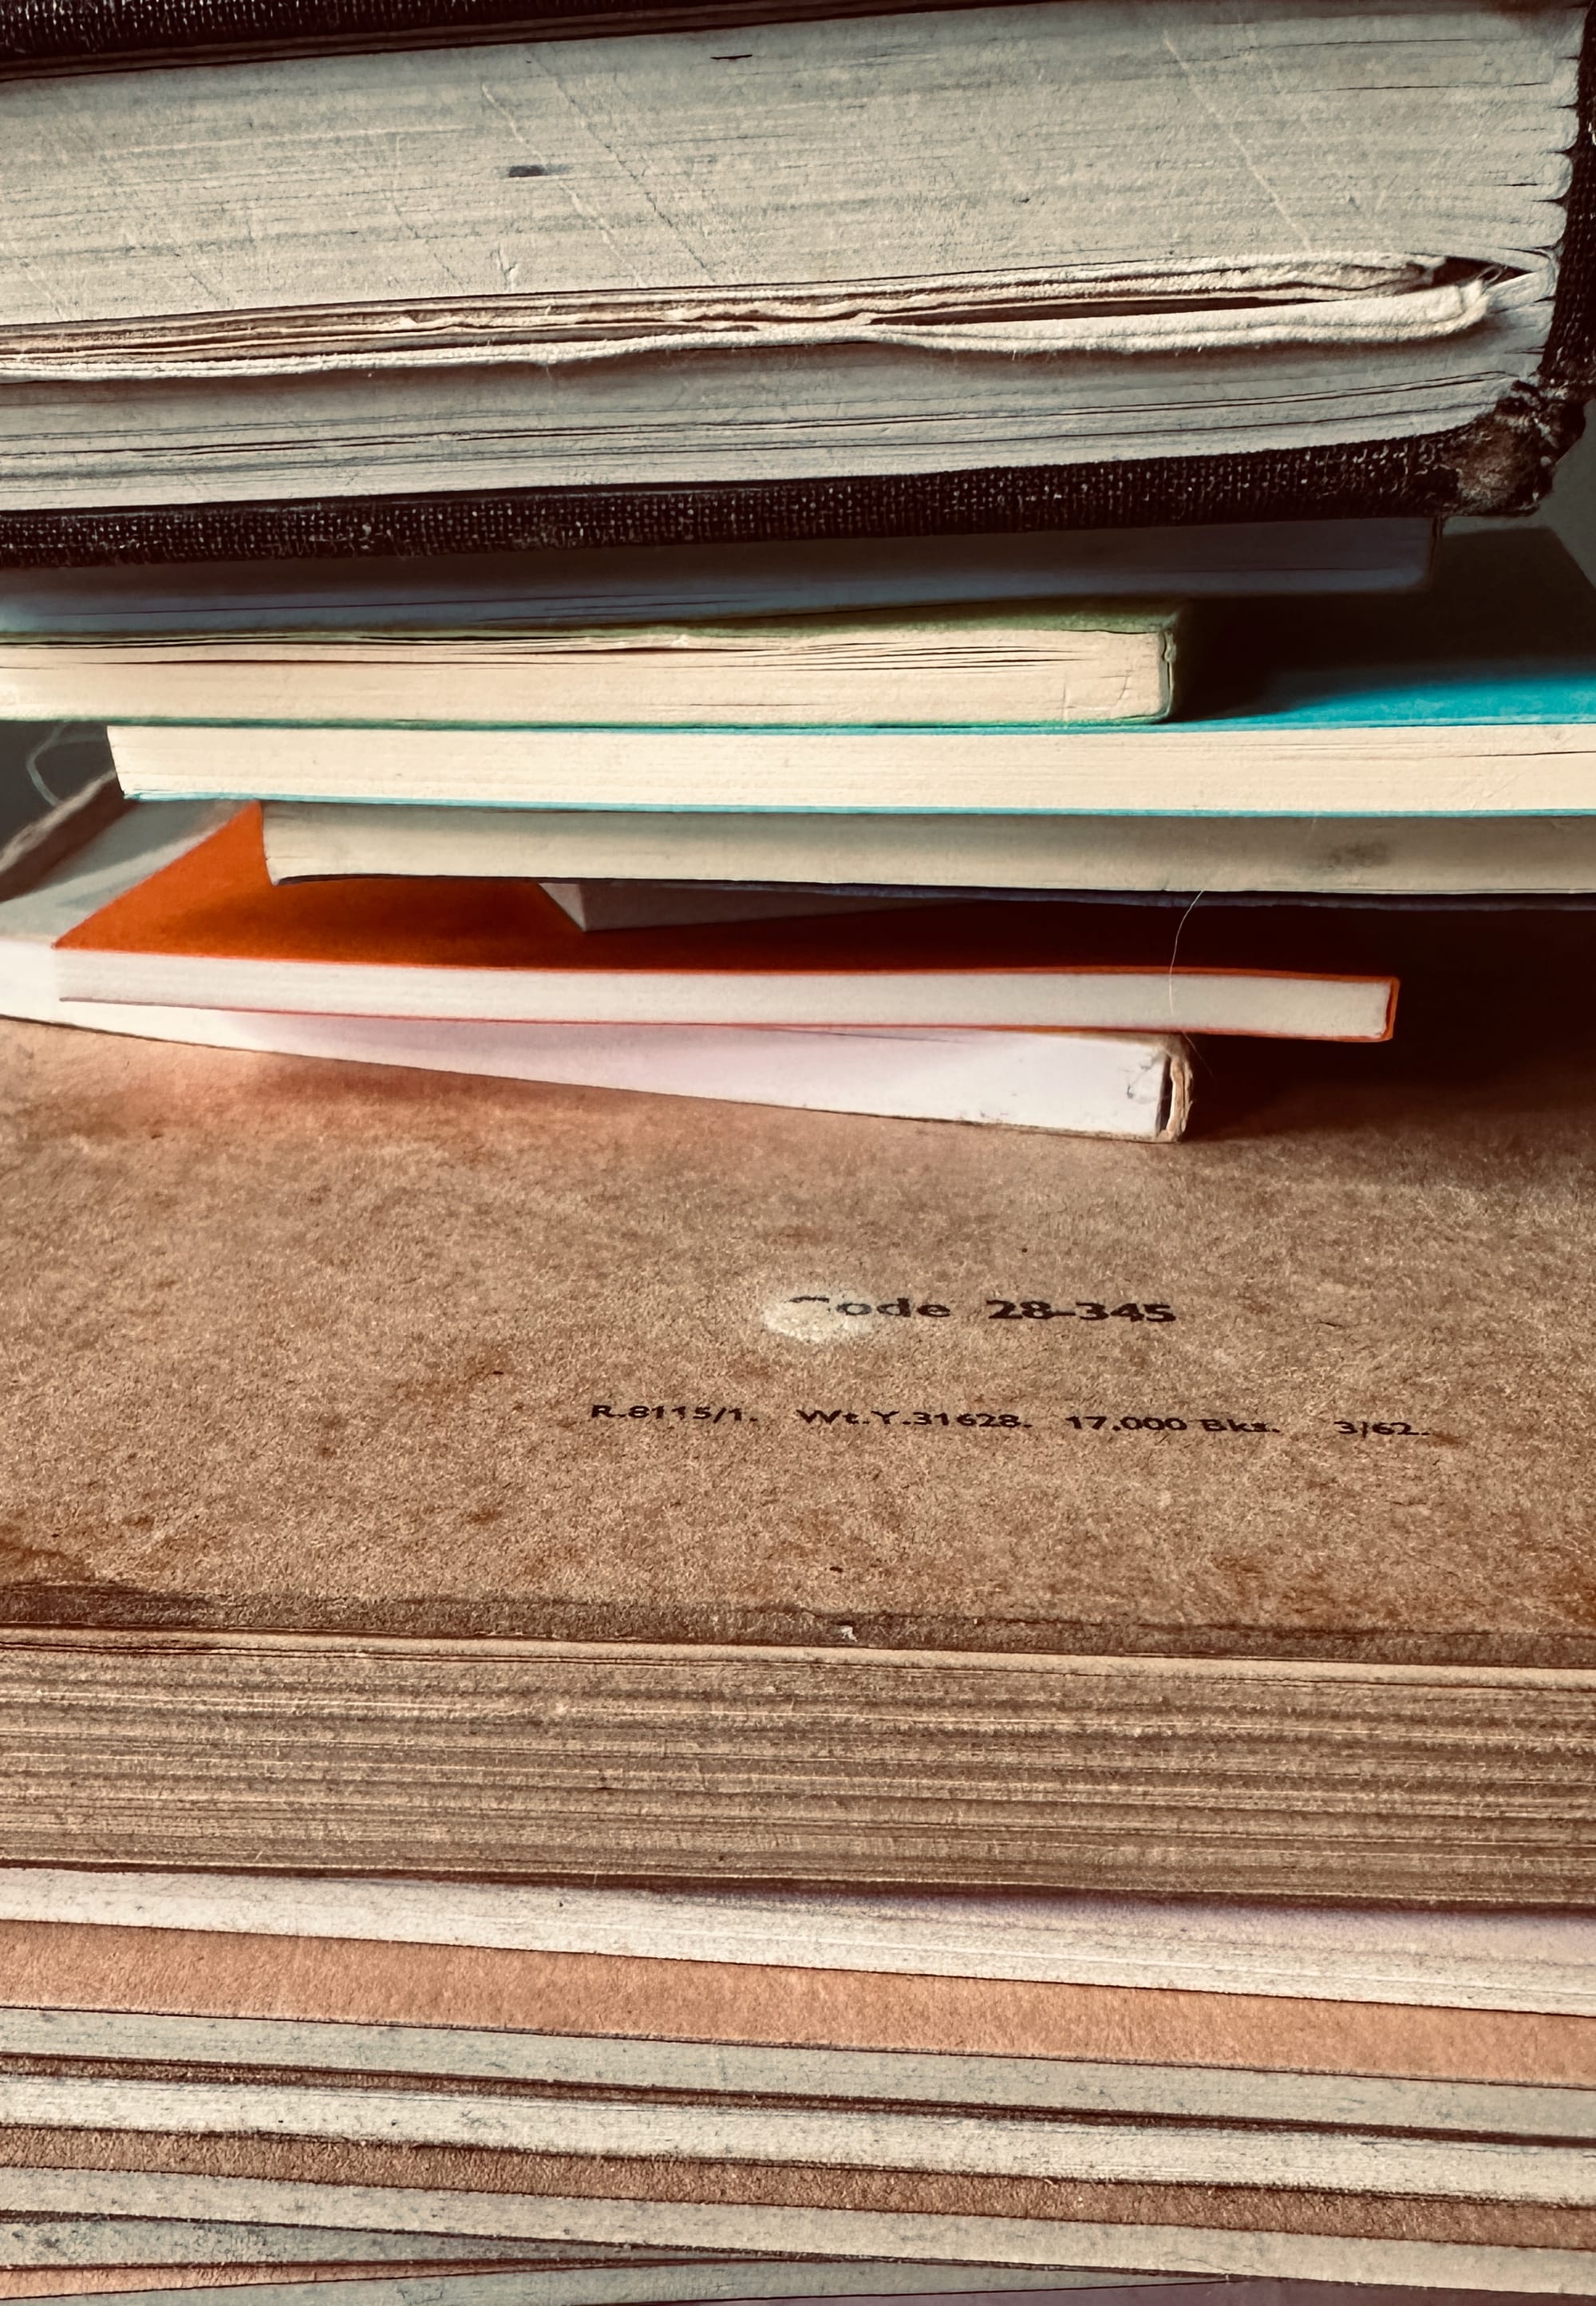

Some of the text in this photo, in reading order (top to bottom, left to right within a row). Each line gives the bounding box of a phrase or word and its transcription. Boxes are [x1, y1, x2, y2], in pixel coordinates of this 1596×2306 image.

[785, 1295, 1177, 1322] ode 28-345
[1200, 1418, 1280, 1433] Bks.
